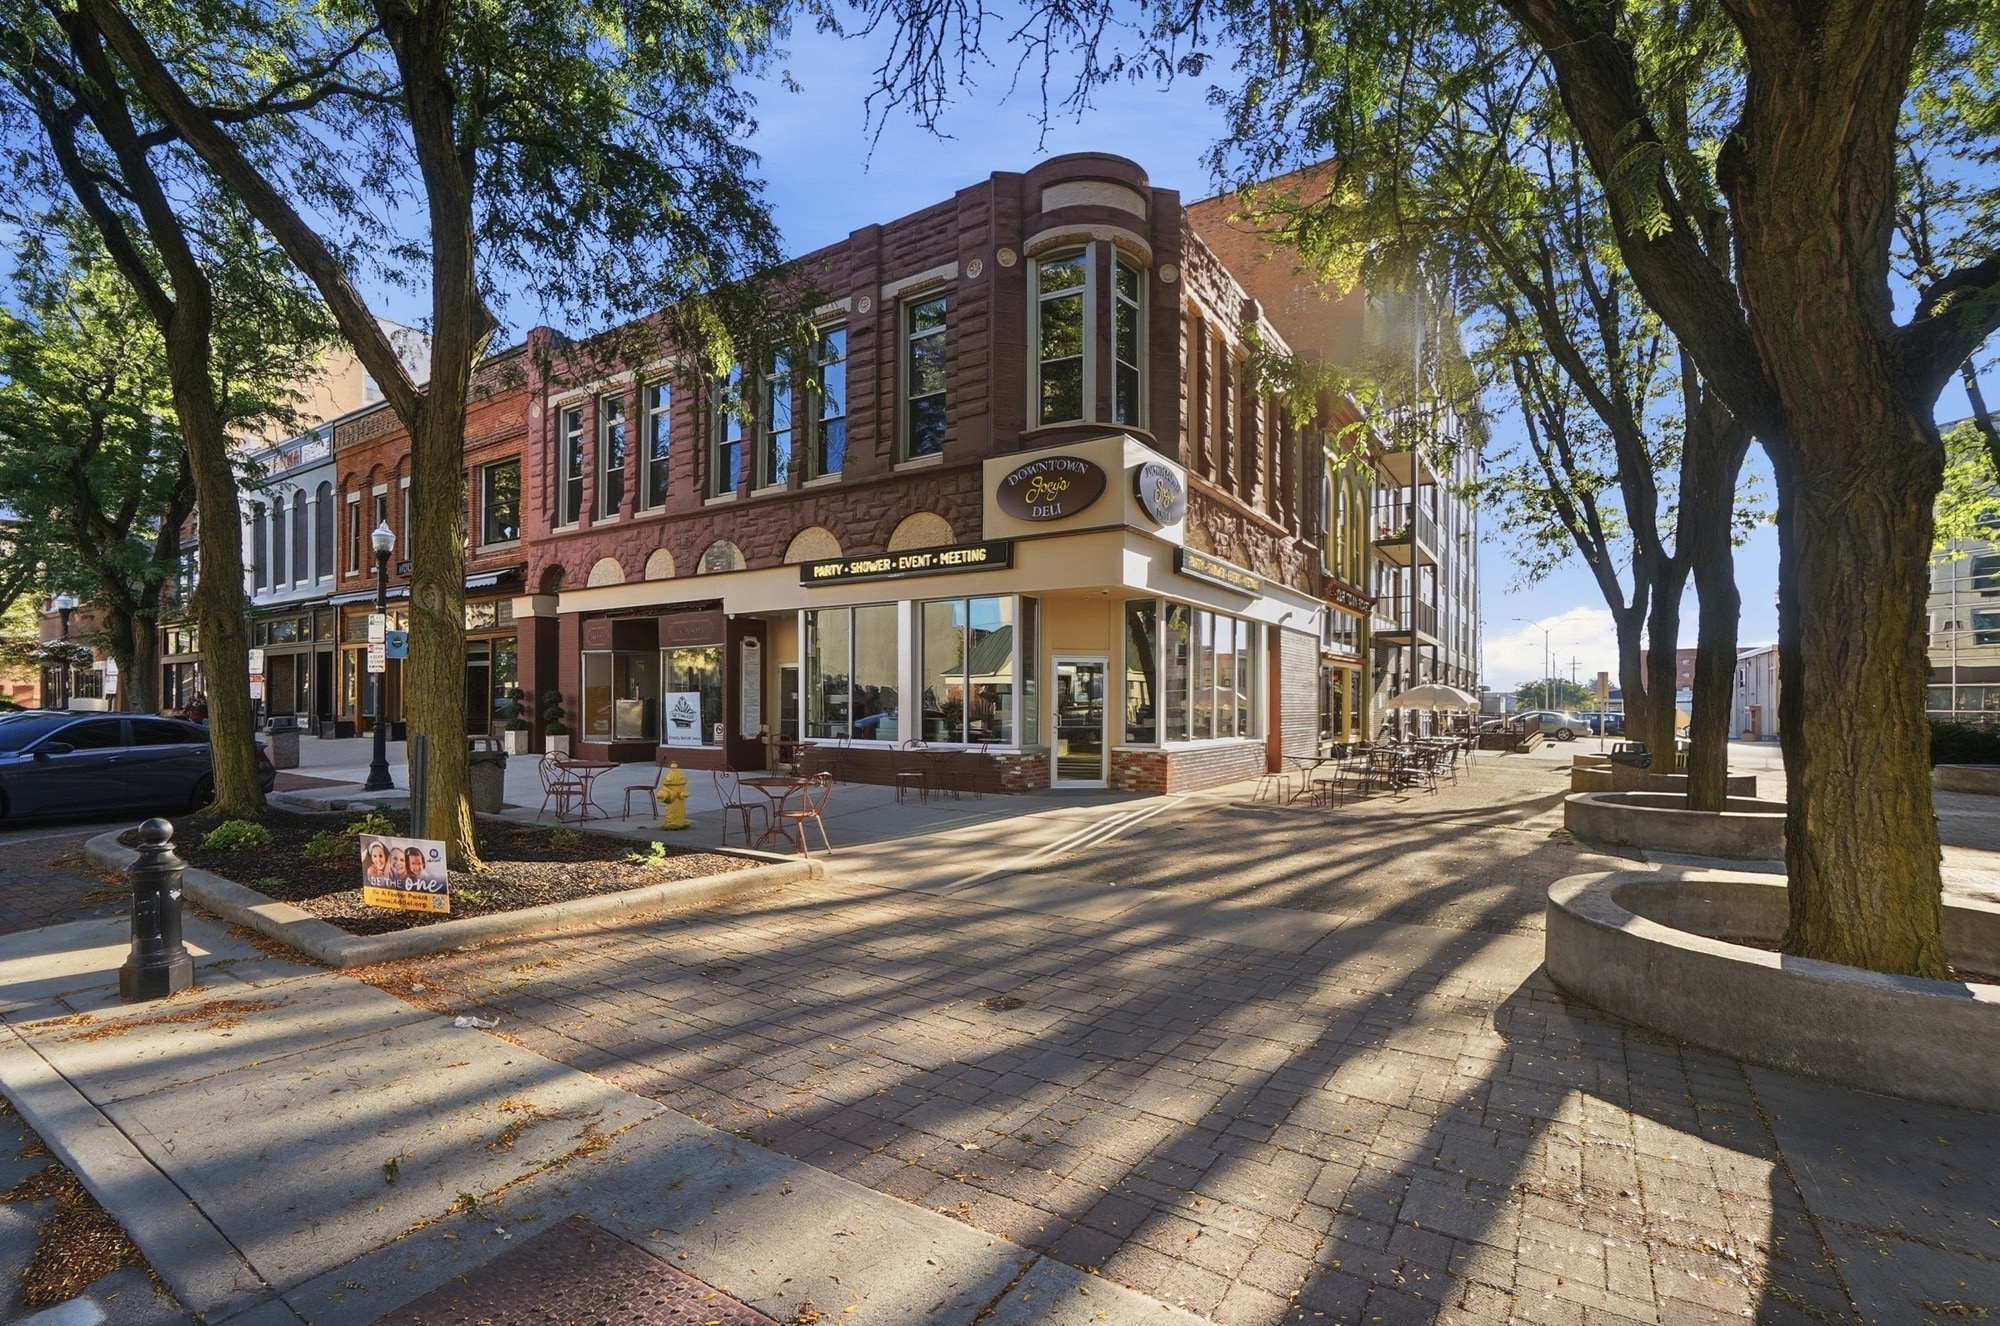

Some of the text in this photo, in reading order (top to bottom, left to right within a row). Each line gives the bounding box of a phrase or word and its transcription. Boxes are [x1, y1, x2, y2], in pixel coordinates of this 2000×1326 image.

[1008, 459, 1088, 486] DOWNTOWN
[1025, 476, 1070, 503] Joey's
[1032, 503, 1061, 517] DELI
[813, 548, 987, 578] PARTY SHOWER EVENT MEETING
[371, 876, 443, 892] BE THE one
